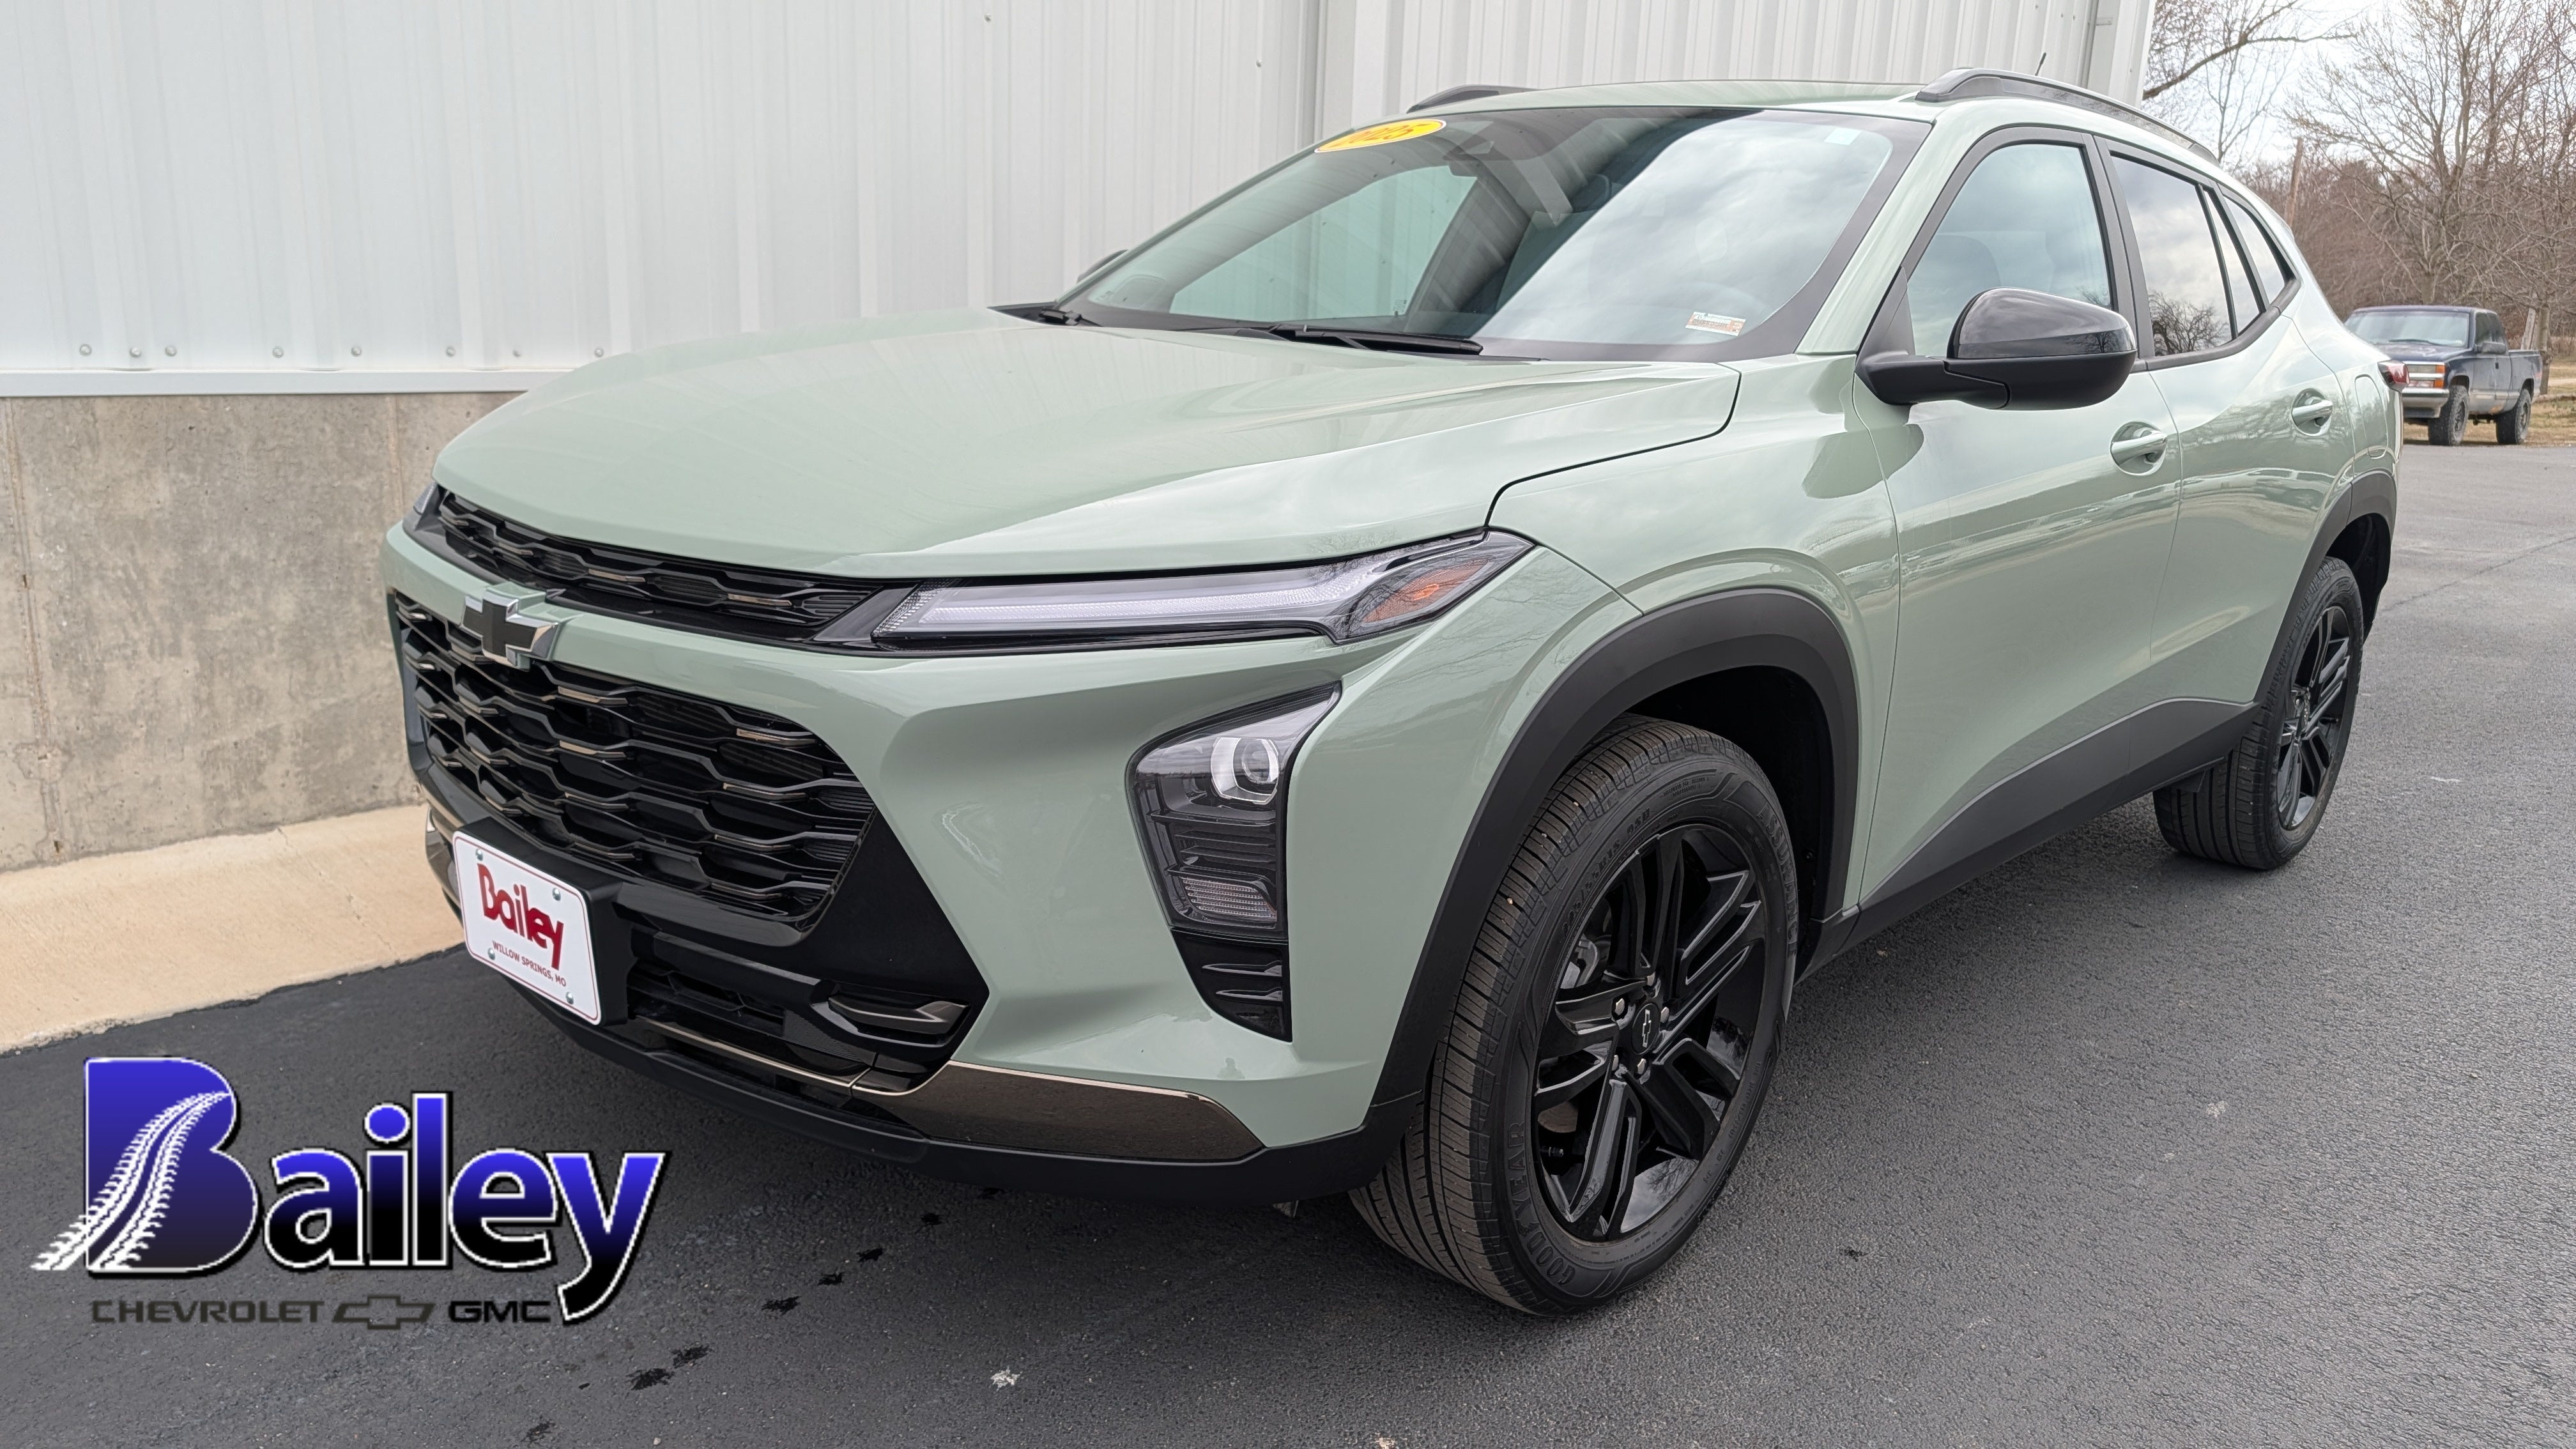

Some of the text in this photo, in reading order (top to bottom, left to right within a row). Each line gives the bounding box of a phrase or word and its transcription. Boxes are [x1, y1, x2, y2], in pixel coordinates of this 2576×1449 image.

[477, 863, 564, 971] Bailey
[493, 940, 567, 987] WILLOW SPRINGS, MO
